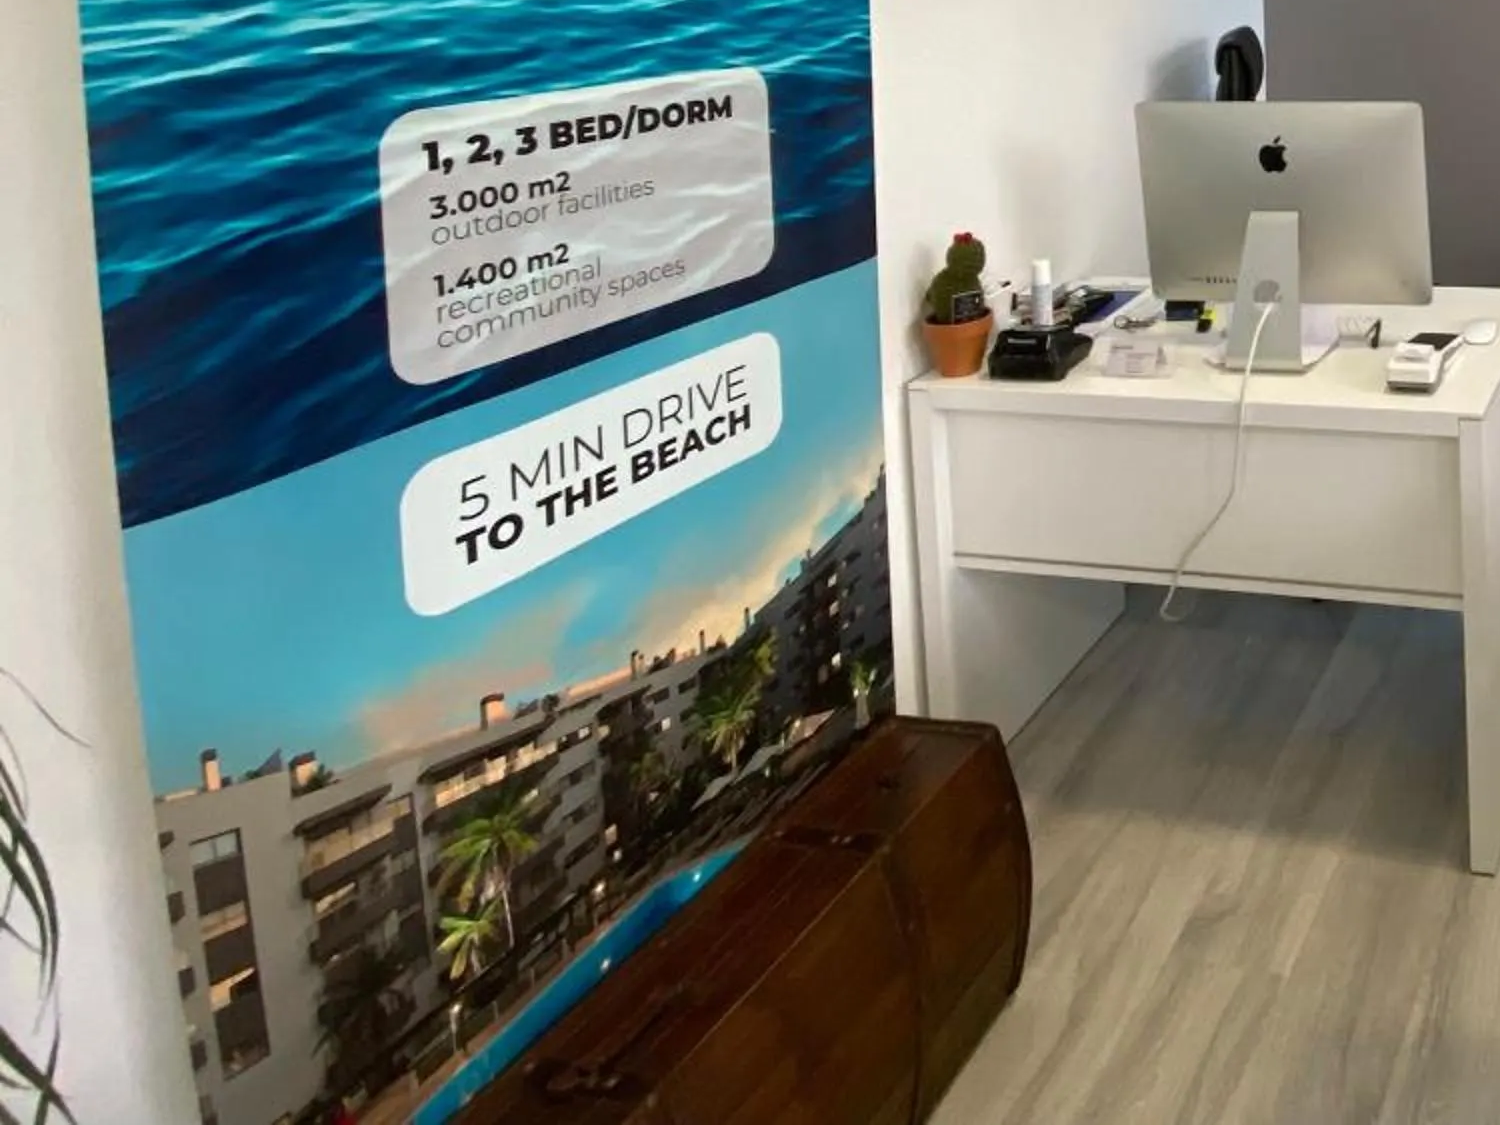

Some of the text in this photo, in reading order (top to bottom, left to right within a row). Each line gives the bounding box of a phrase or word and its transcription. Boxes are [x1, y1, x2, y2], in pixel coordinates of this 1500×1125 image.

[421, 95, 734, 175] 1, 2, 3 BED/DORM
[429, 171, 573, 220] 3.000 m2
[431, 177, 657, 245] outdoor facilities
[433, 243, 571, 298] 1.400 m2
[435, 257, 602, 324] recreational
[437, 256, 687, 350] community spaces
[460, 364, 749, 523] 5 MIN DRIVE
[455, 404, 753, 567] TO THE BEACH
